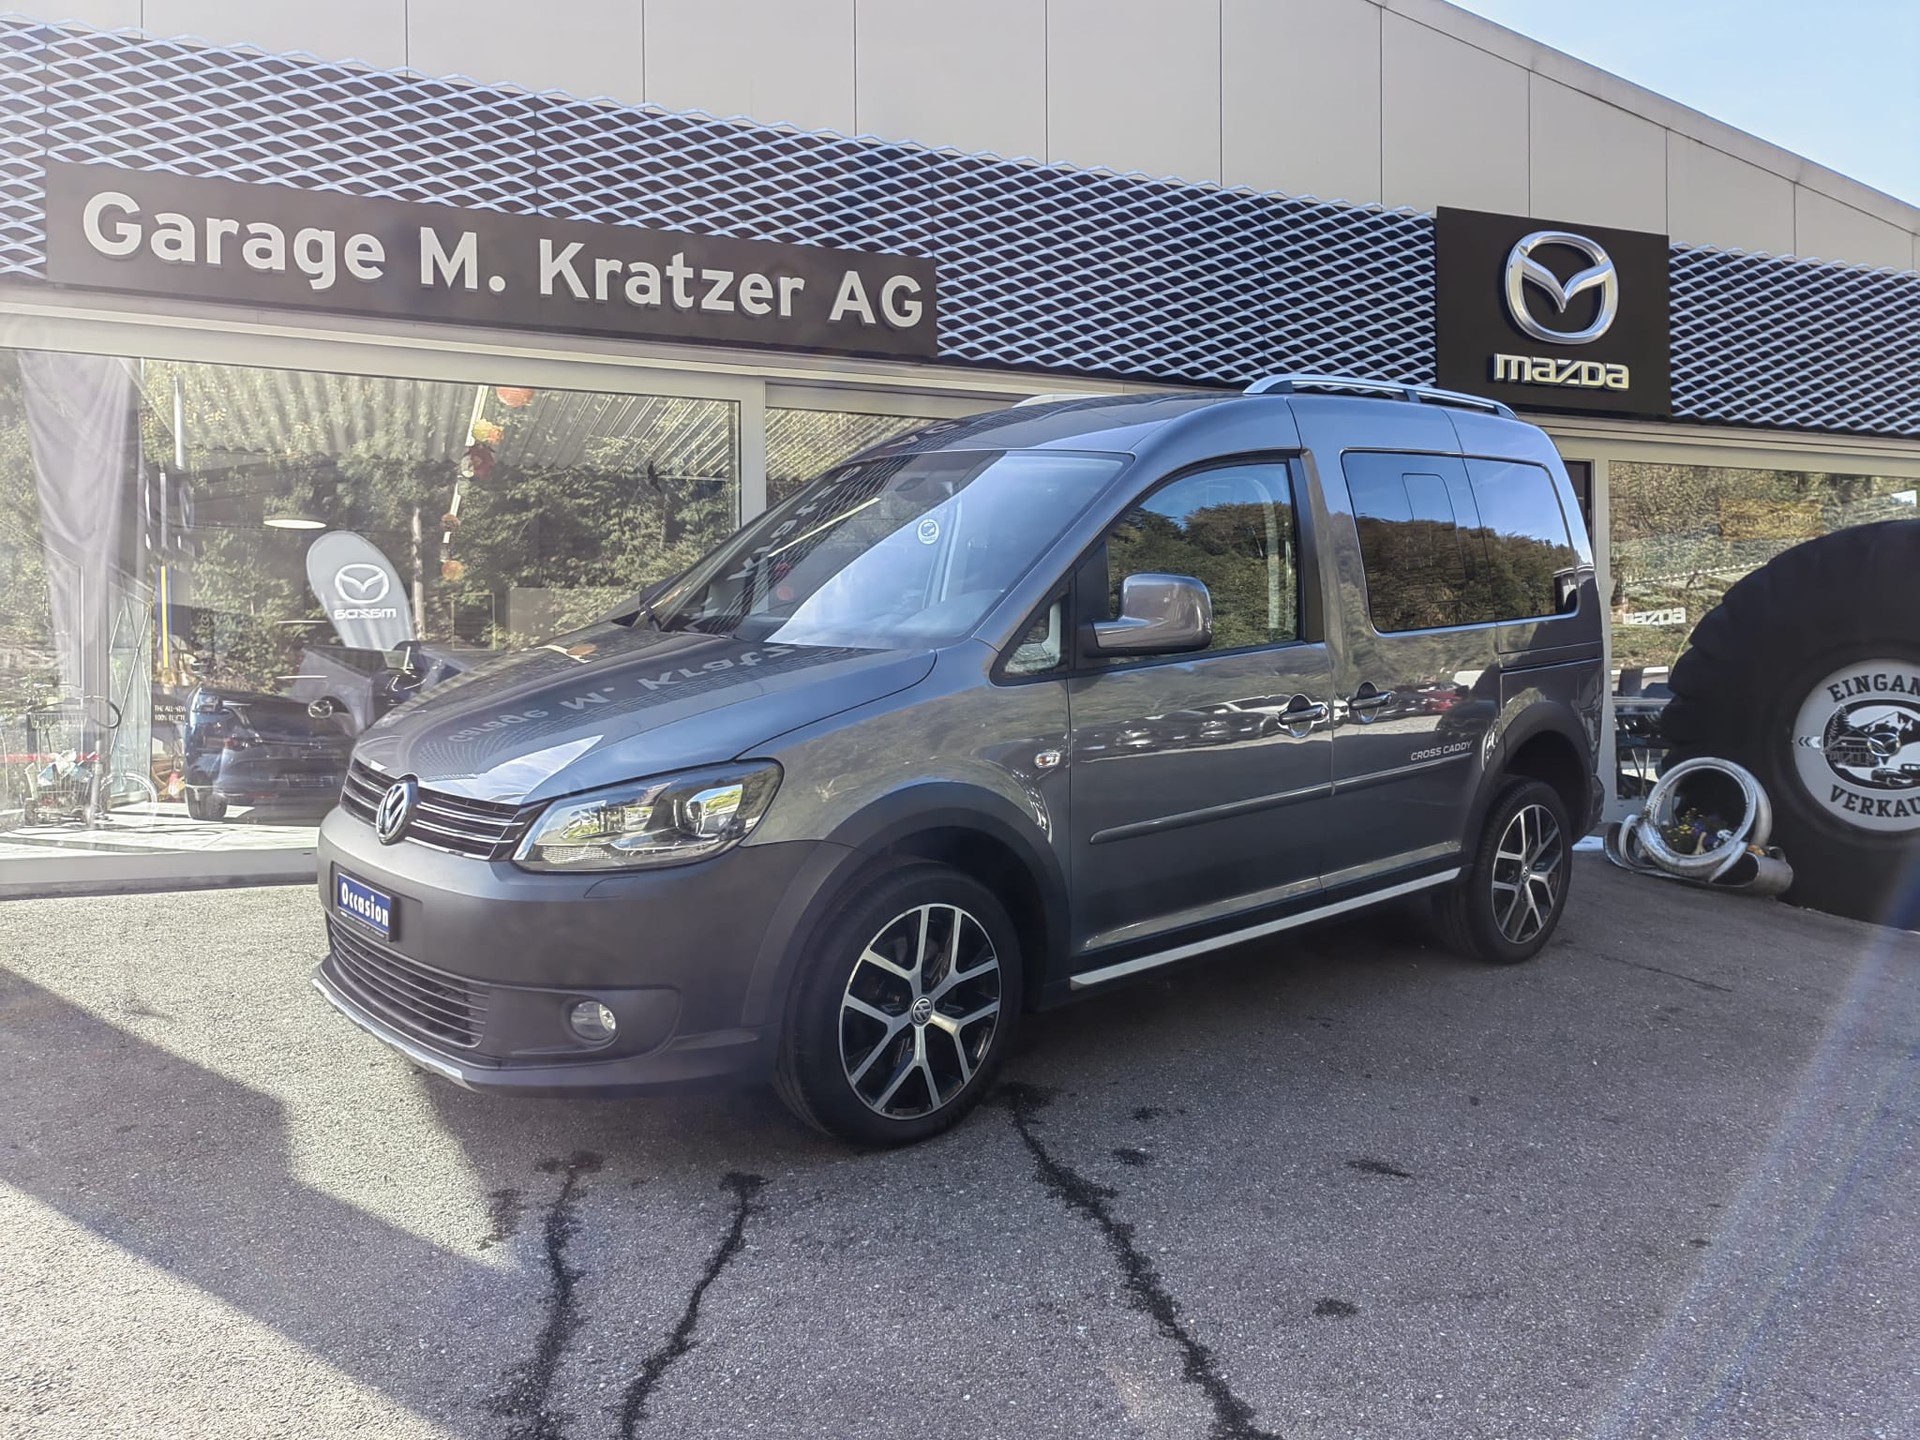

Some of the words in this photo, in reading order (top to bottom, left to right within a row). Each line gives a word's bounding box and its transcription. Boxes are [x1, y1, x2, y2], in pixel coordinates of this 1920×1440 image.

[83, 191, 386, 291] Garage
[419, 226, 507, 293] M.
[539, 238, 805, 318] Kratzer
[827, 269, 924, 329] AG
[1410, 746, 1442, 761] CROSS
[1443, 740, 1473, 755] CADDY
[341, 881, 389, 928] Occasion
